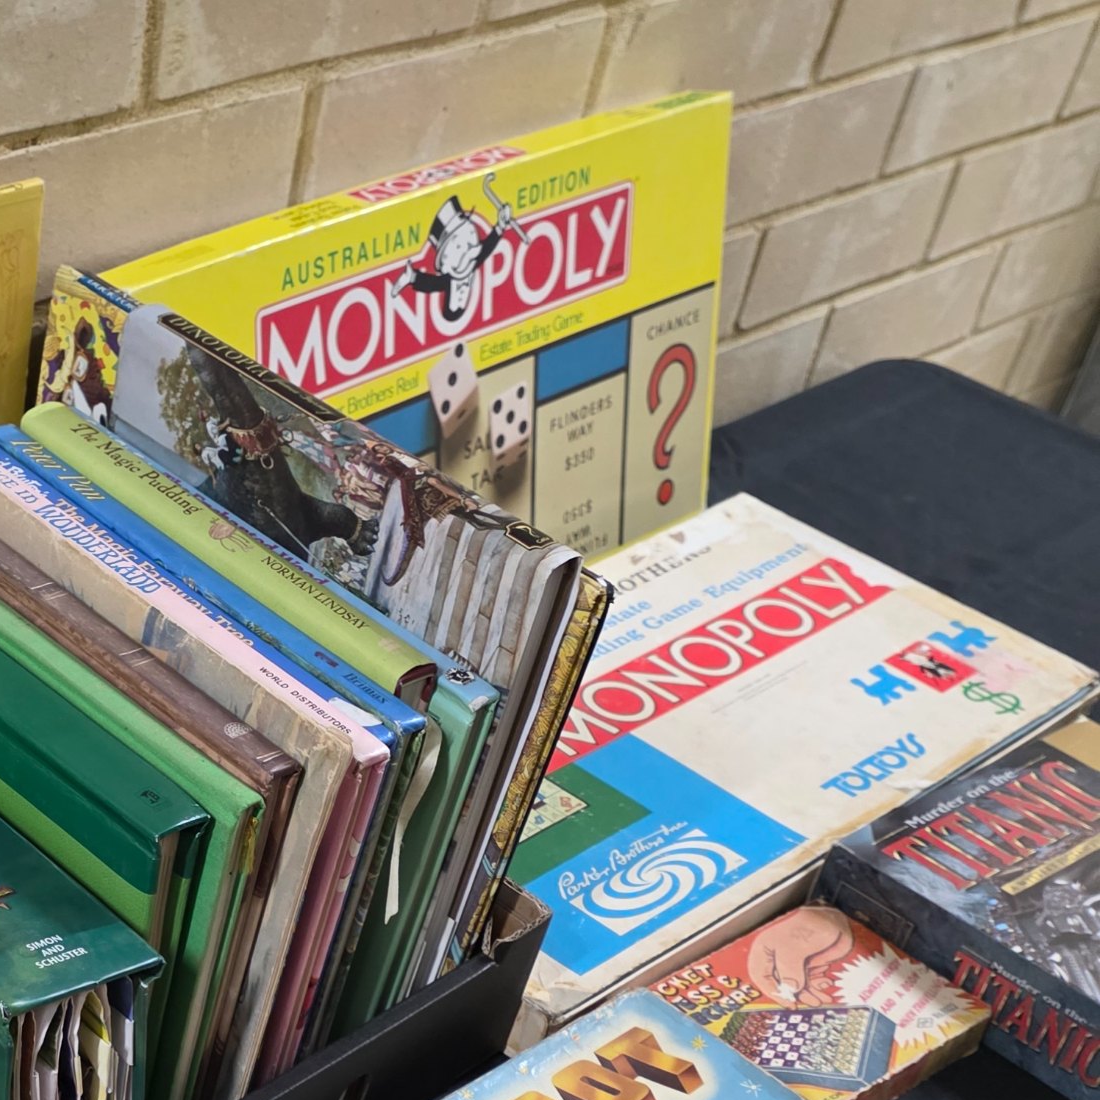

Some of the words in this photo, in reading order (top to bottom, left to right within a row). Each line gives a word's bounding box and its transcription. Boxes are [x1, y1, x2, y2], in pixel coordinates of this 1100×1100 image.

[280, 222, 421, 292] AUSTRALIAN
[516, 165, 592, 210] EDITION
[266, 196, 627, 390] MONOPOLY
[645, 308, 702, 341] CHANCE
[168, 315, 272, 381] DINOTOPIA
[549, 394, 614, 432] FLINDERS
[566, 421, 596, 444] WAY
[11, 438, 68, 473] Peter
[58, 474, 106, 501] Pan
[69, 421, 99, 444] The
[97, 439, 142, 473] Magic
[138, 471, 202, 517] Pudding
[56, 497, 86, 525] The
[260, 554, 318, 596] NORMAN
[313, 591, 371, 631] LINDSAY
[641, 596, 704, 631] Game
[703, 543, 809, 600] Equipment
[554, 563, 866, 757] MONOPOLY
[259, 664, 290, 691] WORLD
[290, 688, 352, 735] DISTRIBUTORS
[820, 732, 929, 798] TOLTOYS
[880, 760, 1100, 892] TITANIC
[904, 795, 965, 830] Murder
[966, 782, 991, 799] on
[989, 767, 1019, 790] the
[25, 933, 64, 952] SIMON
[34, 945, 89, 970] SCHUSTER
[40, 943, 66, 959] AND
[950, 950, 1100, 1088] TITANIC
[989, 960, 1041, 996] Murder
[1042, 994, 1062, 1010] on
[1064, 1004, 1088, 1024] the
